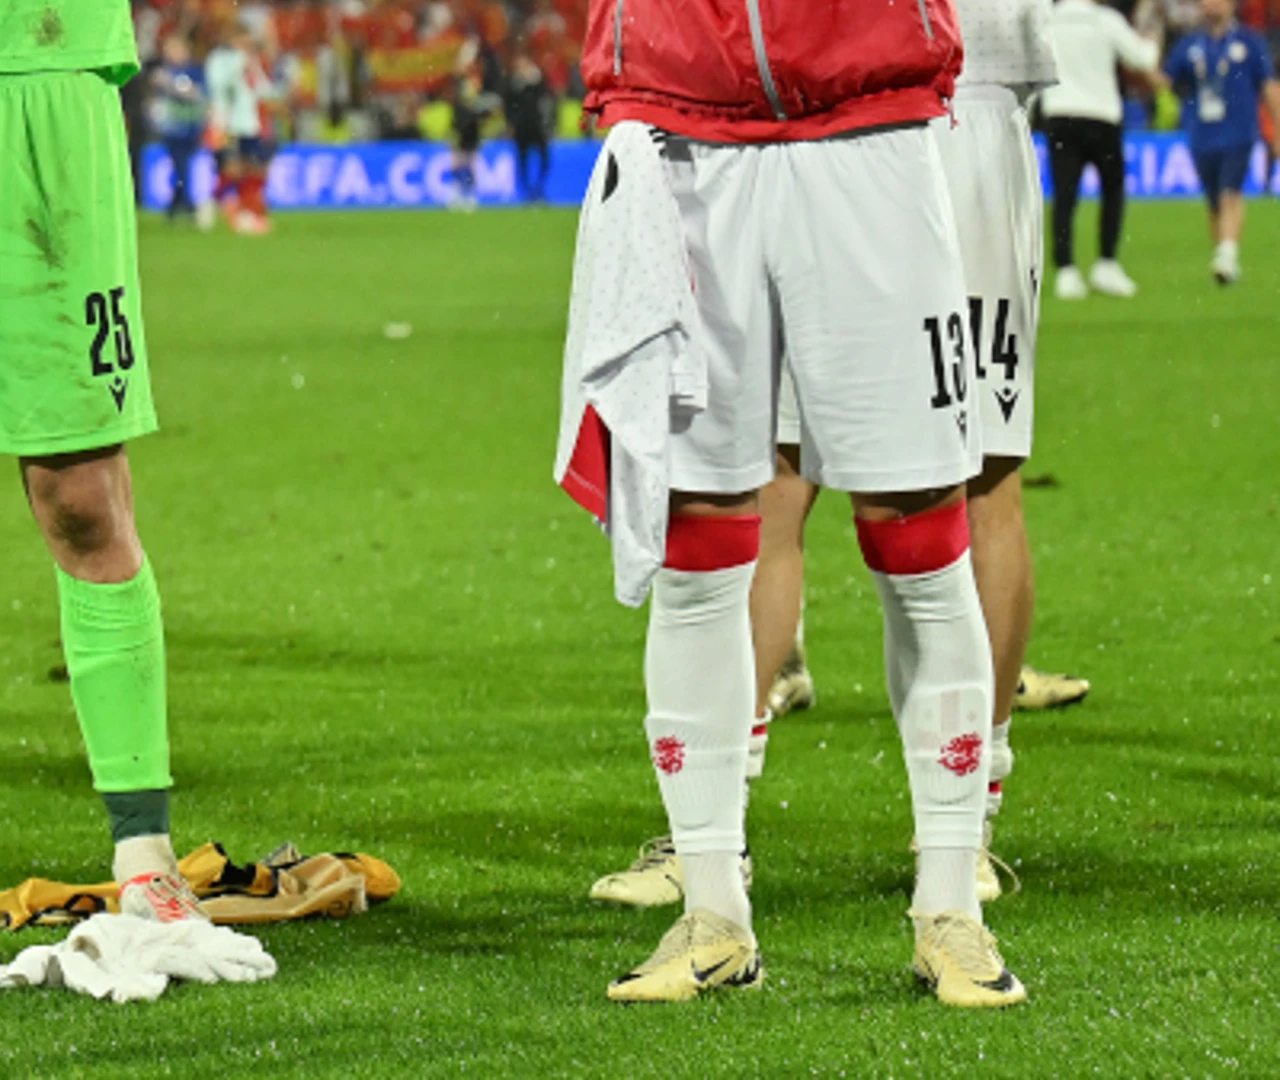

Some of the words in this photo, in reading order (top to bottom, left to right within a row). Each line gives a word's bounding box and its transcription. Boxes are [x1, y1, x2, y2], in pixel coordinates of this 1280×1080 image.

[85, 286, 135, 377] 25
[924, 311, 967, 409] 13
[967, 296, 1018, 380] 14
